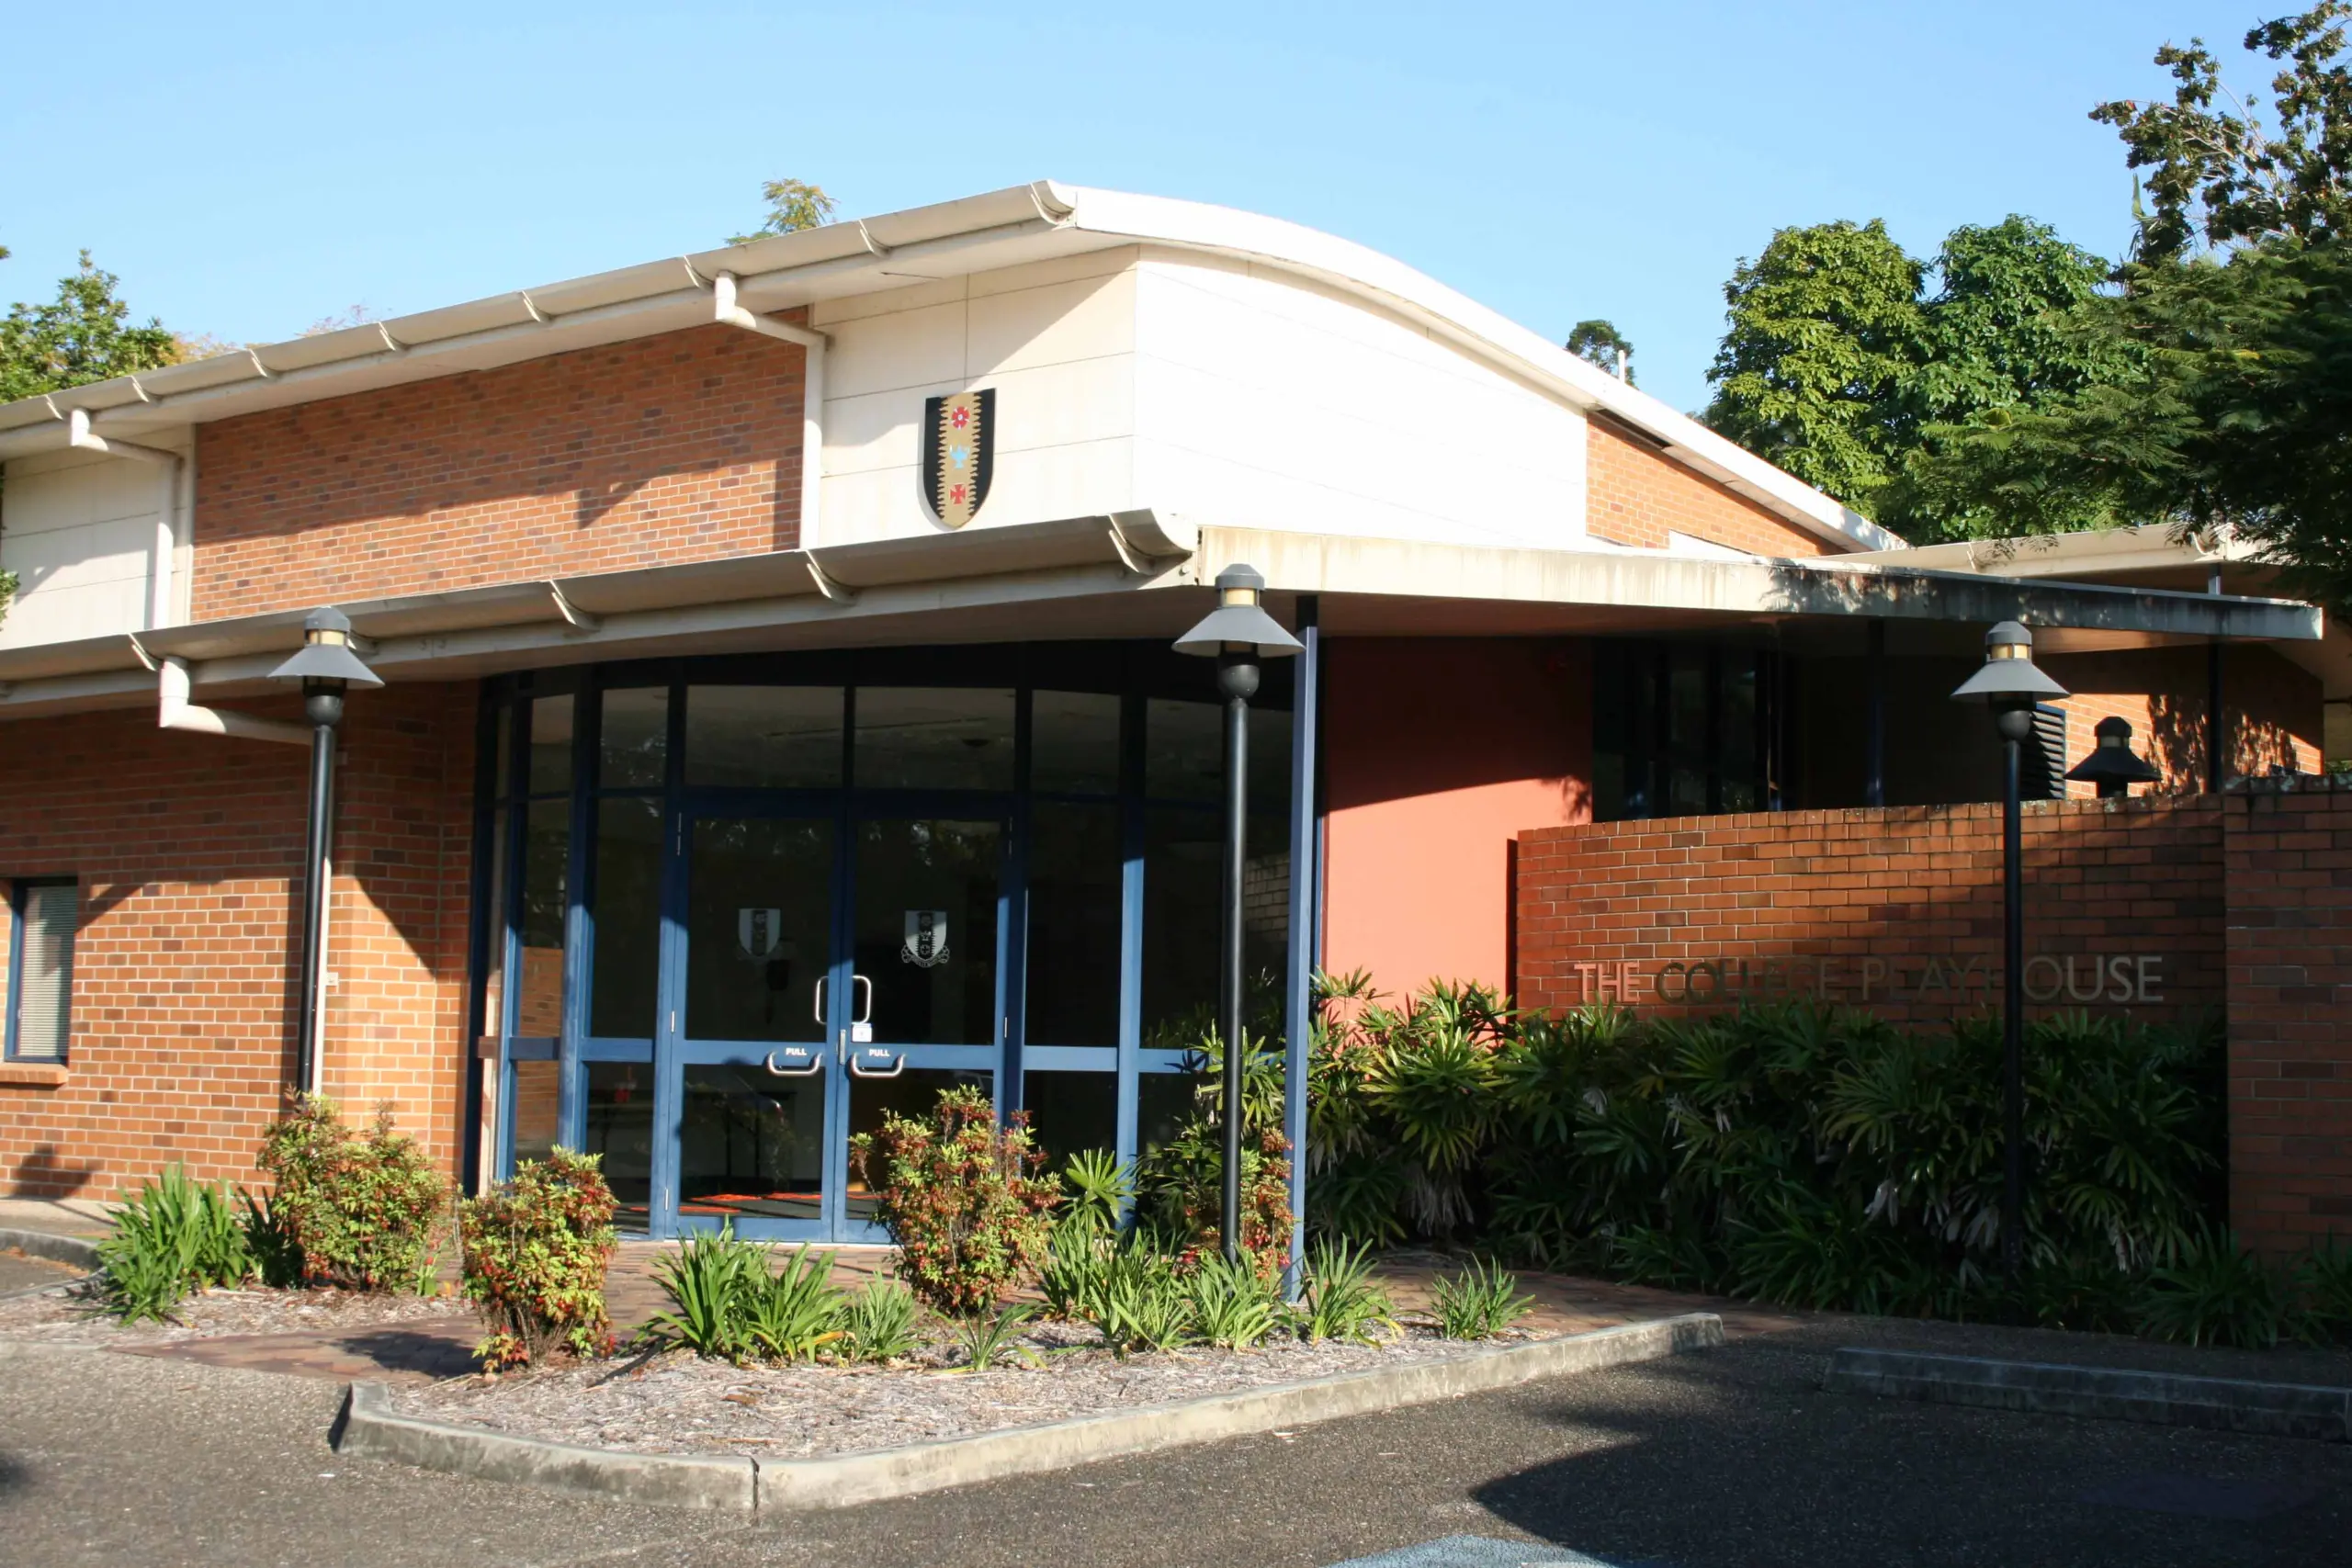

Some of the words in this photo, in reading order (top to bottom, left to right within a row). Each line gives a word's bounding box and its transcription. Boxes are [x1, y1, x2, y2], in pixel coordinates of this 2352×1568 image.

[1574, 962, 1641, 1003] THE
[1657, 956, 1841, 1005] COLLEGE
[786, 1047, 807, 1055] PULL
[868, 1049, 890, 1057] PULL
